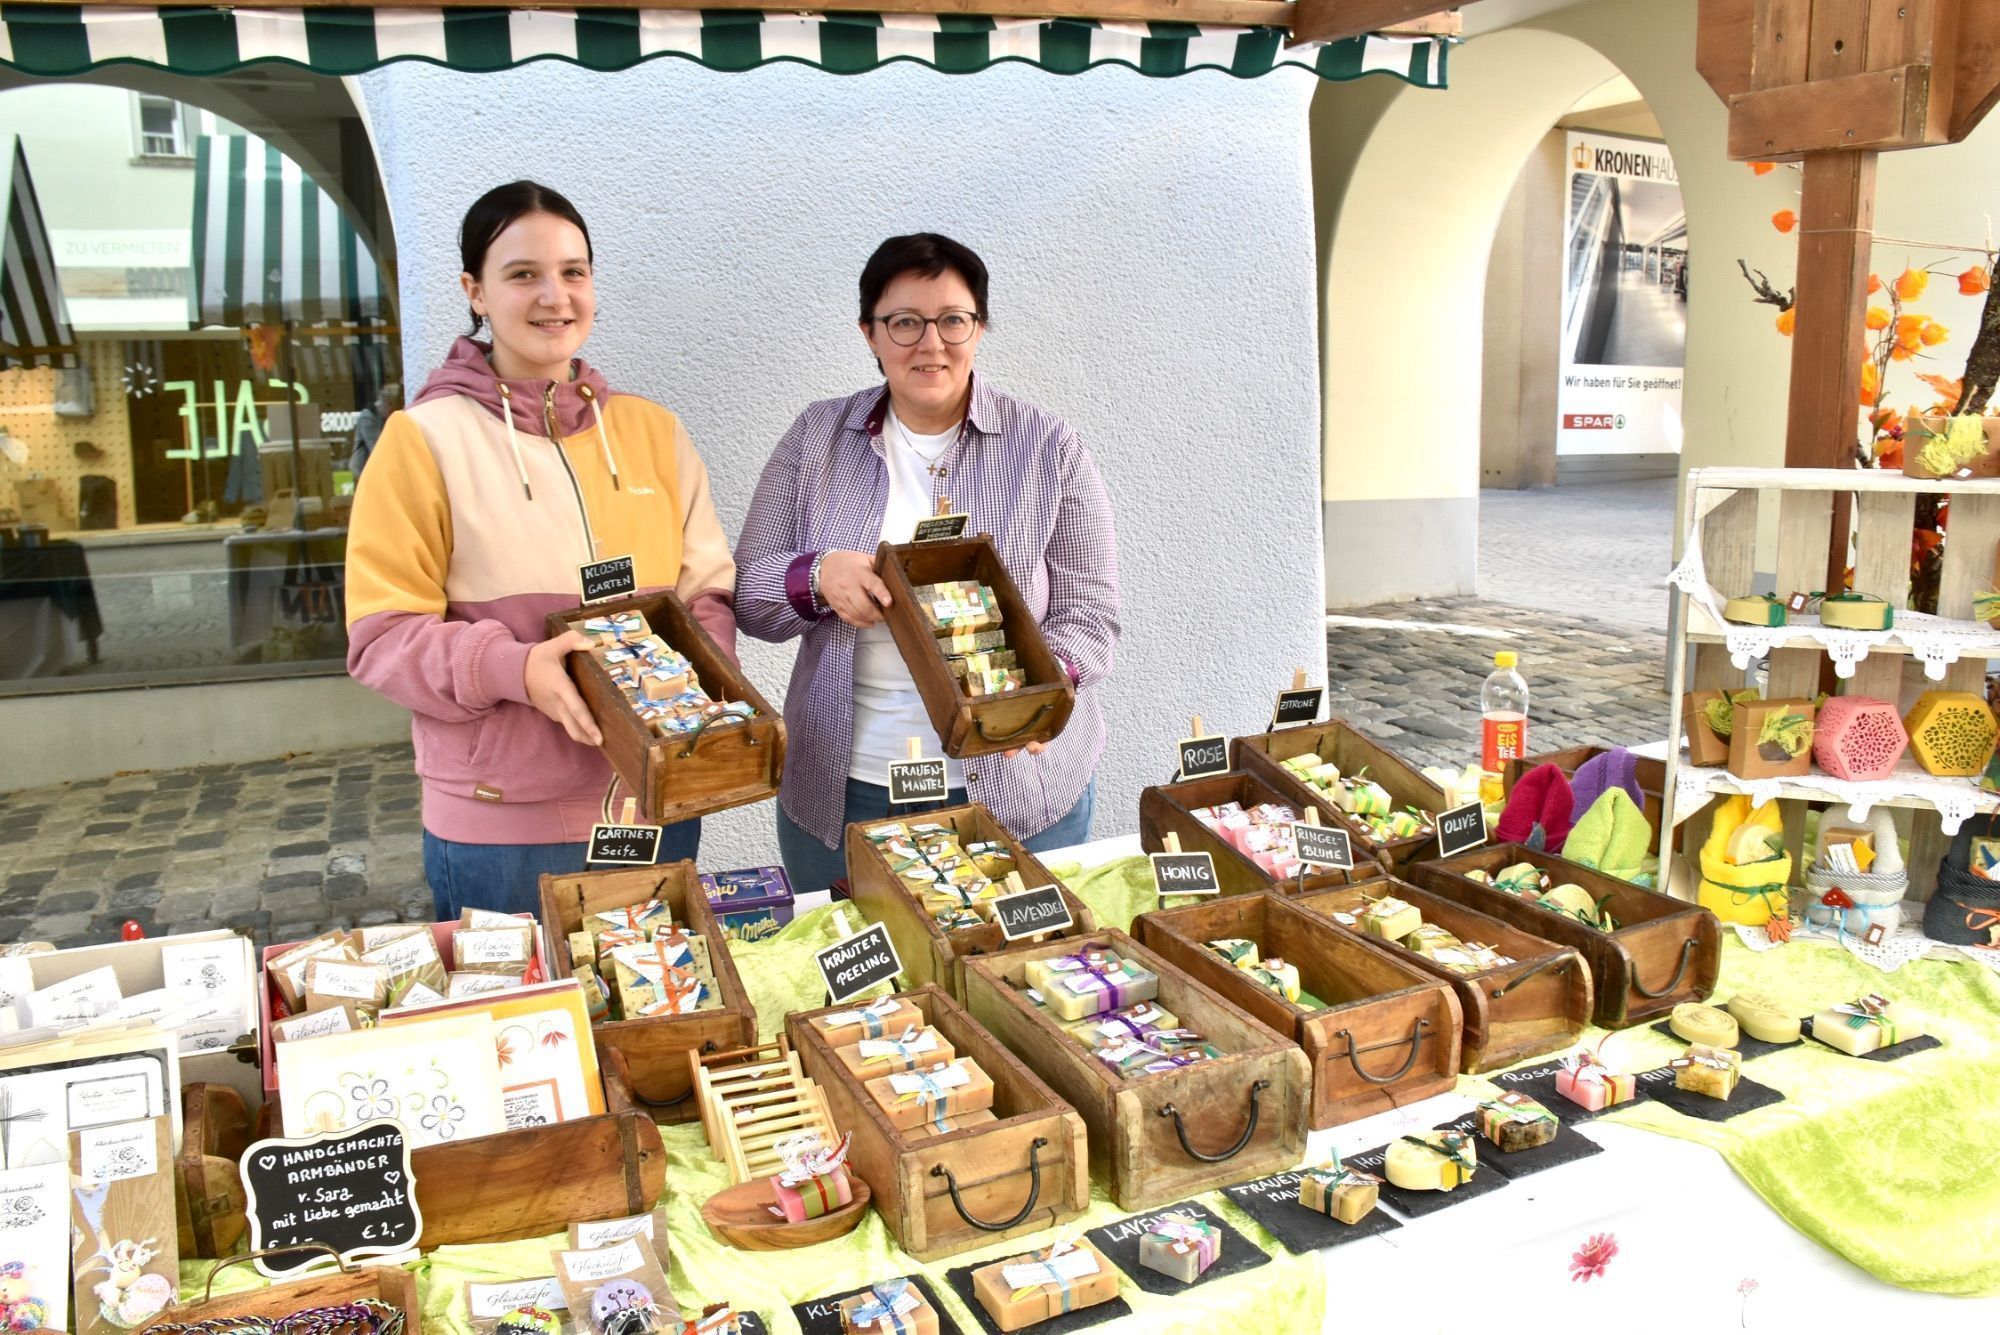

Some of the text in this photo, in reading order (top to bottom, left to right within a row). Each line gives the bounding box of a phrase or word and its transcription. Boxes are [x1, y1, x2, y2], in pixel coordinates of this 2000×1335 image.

[1594, 148, 1679, 181] KRONENHAU
[90, 241, 180, 255] VERMIETEN
[1565, 376, 1681, 392] Wir haben für Sie geöffnet!
[1573, 416, 1613, 428] SPAR
[585, 559, 633, 580] KLOSTER
[588, 574, 632, 595] GARTEN
[1280, 698, 1316, 711] ZITRONE
[1184, 744, 1224, 769] ROSE
[891, 764, 944, 778] FRAUEN-
[902, 778, 945, 793] MANTEL
[1444, 812, 1477, 834] OLIVE
[597, 827, 655, 840] GÄRTNER
[1296, 827, 1343, 844] RINGEL-
[598, 844, 639, 858] Seife
[1302, 846, 1342, 861] BLUME
[1161, 865, 1210, 881] HONIG
[1002, 901, 1066, 927] LAVENDEL
[823, 933, 881, 970] KRÄUTER
[836, 952, 891, 986] PEELING
[283, 1134, 402, 1167] HANDGEMACHTE
[288, 1154, 389, 1185] ARMBÄNDER
[314, 1187, 353, 1203] Sara
[272, 1188, 405, 1229] mit Liebe gemacht
[361, 1225, 376, 1239] €
